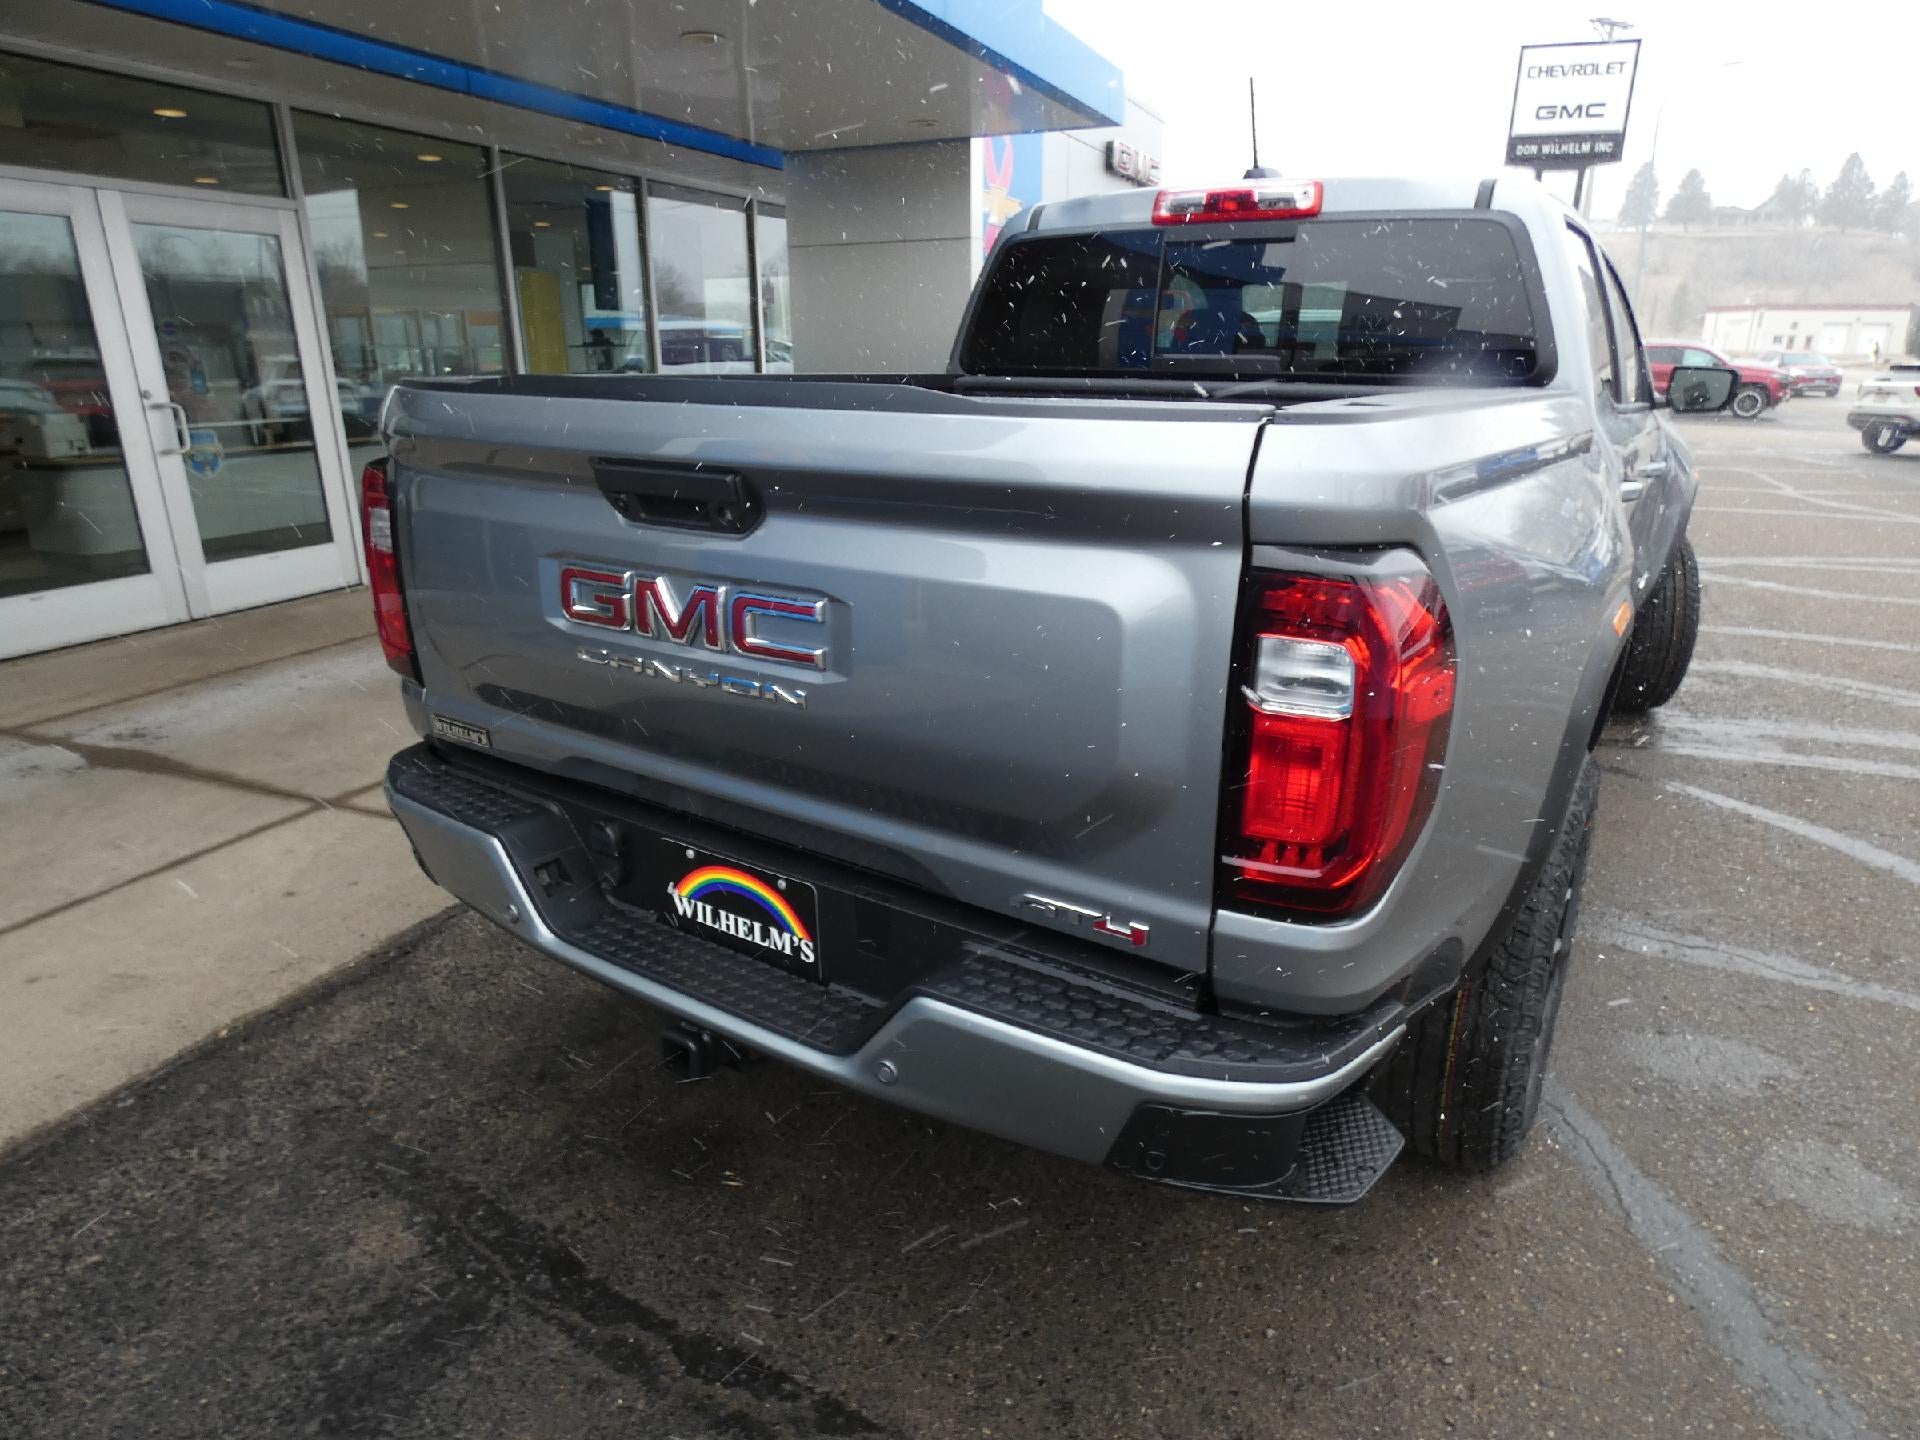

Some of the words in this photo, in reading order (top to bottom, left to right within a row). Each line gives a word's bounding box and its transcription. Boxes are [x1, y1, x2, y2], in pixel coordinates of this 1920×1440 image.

[1527, 61, 1626, 78] CHEVROLET
[1535, 102, 1606, 120] GMC
[1516, 144, 1538, 156] DON
[1541, 143, 1591, 155] WILHELM
[1594, 142, 1613, 153] INC
[560, 565, 828, 673] GMC
[577, 649, 807, 709] CANYON
[669, 883, 815, 963] WILHELM'S
[1009, 893, 1150, 948] AT4
